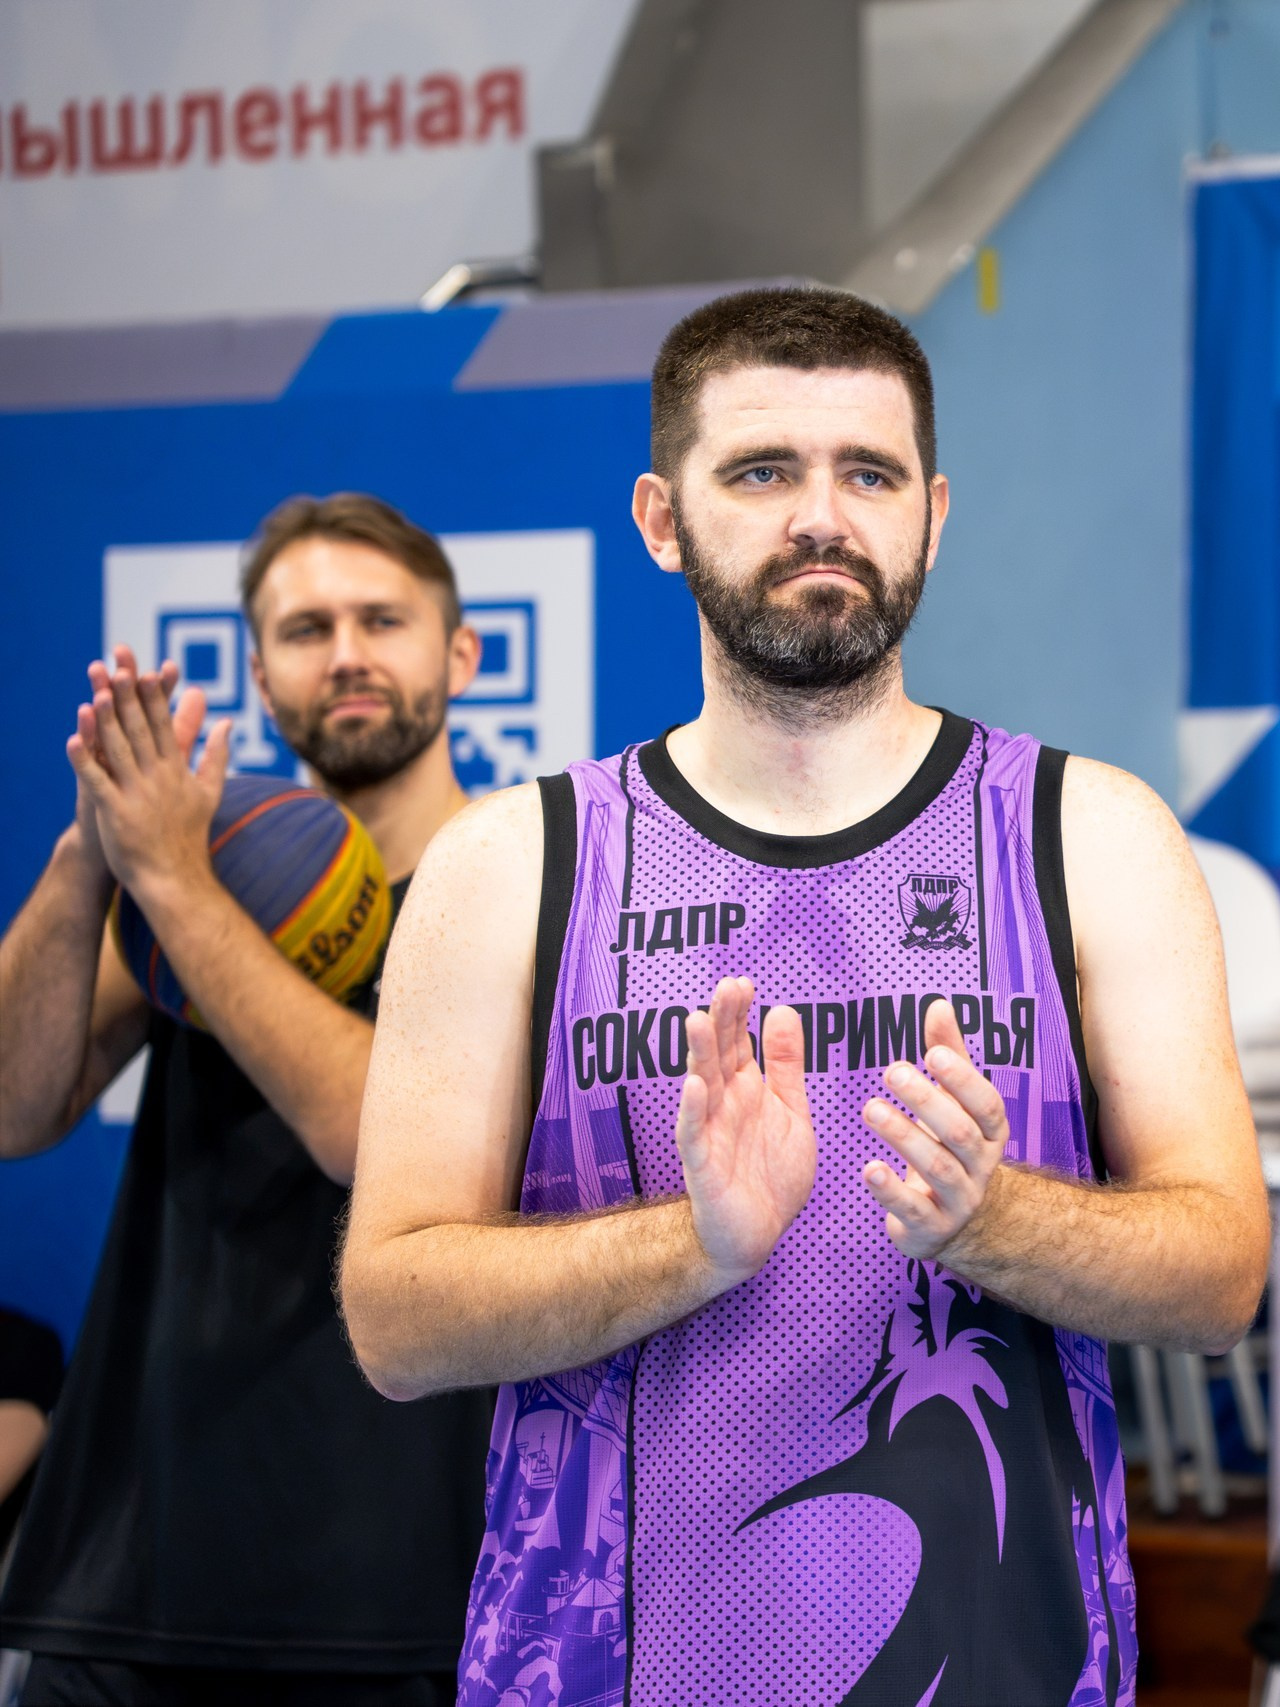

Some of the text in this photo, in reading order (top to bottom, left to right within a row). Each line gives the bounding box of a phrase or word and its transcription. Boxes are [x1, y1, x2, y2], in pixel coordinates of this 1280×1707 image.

[0, 67, 526, 181] ышленная
[910, 877, 959, 896] ЛДПР
[609, 902, 746, 957] ЛДПР
[572, 1004, 766, 1091] СОКО
